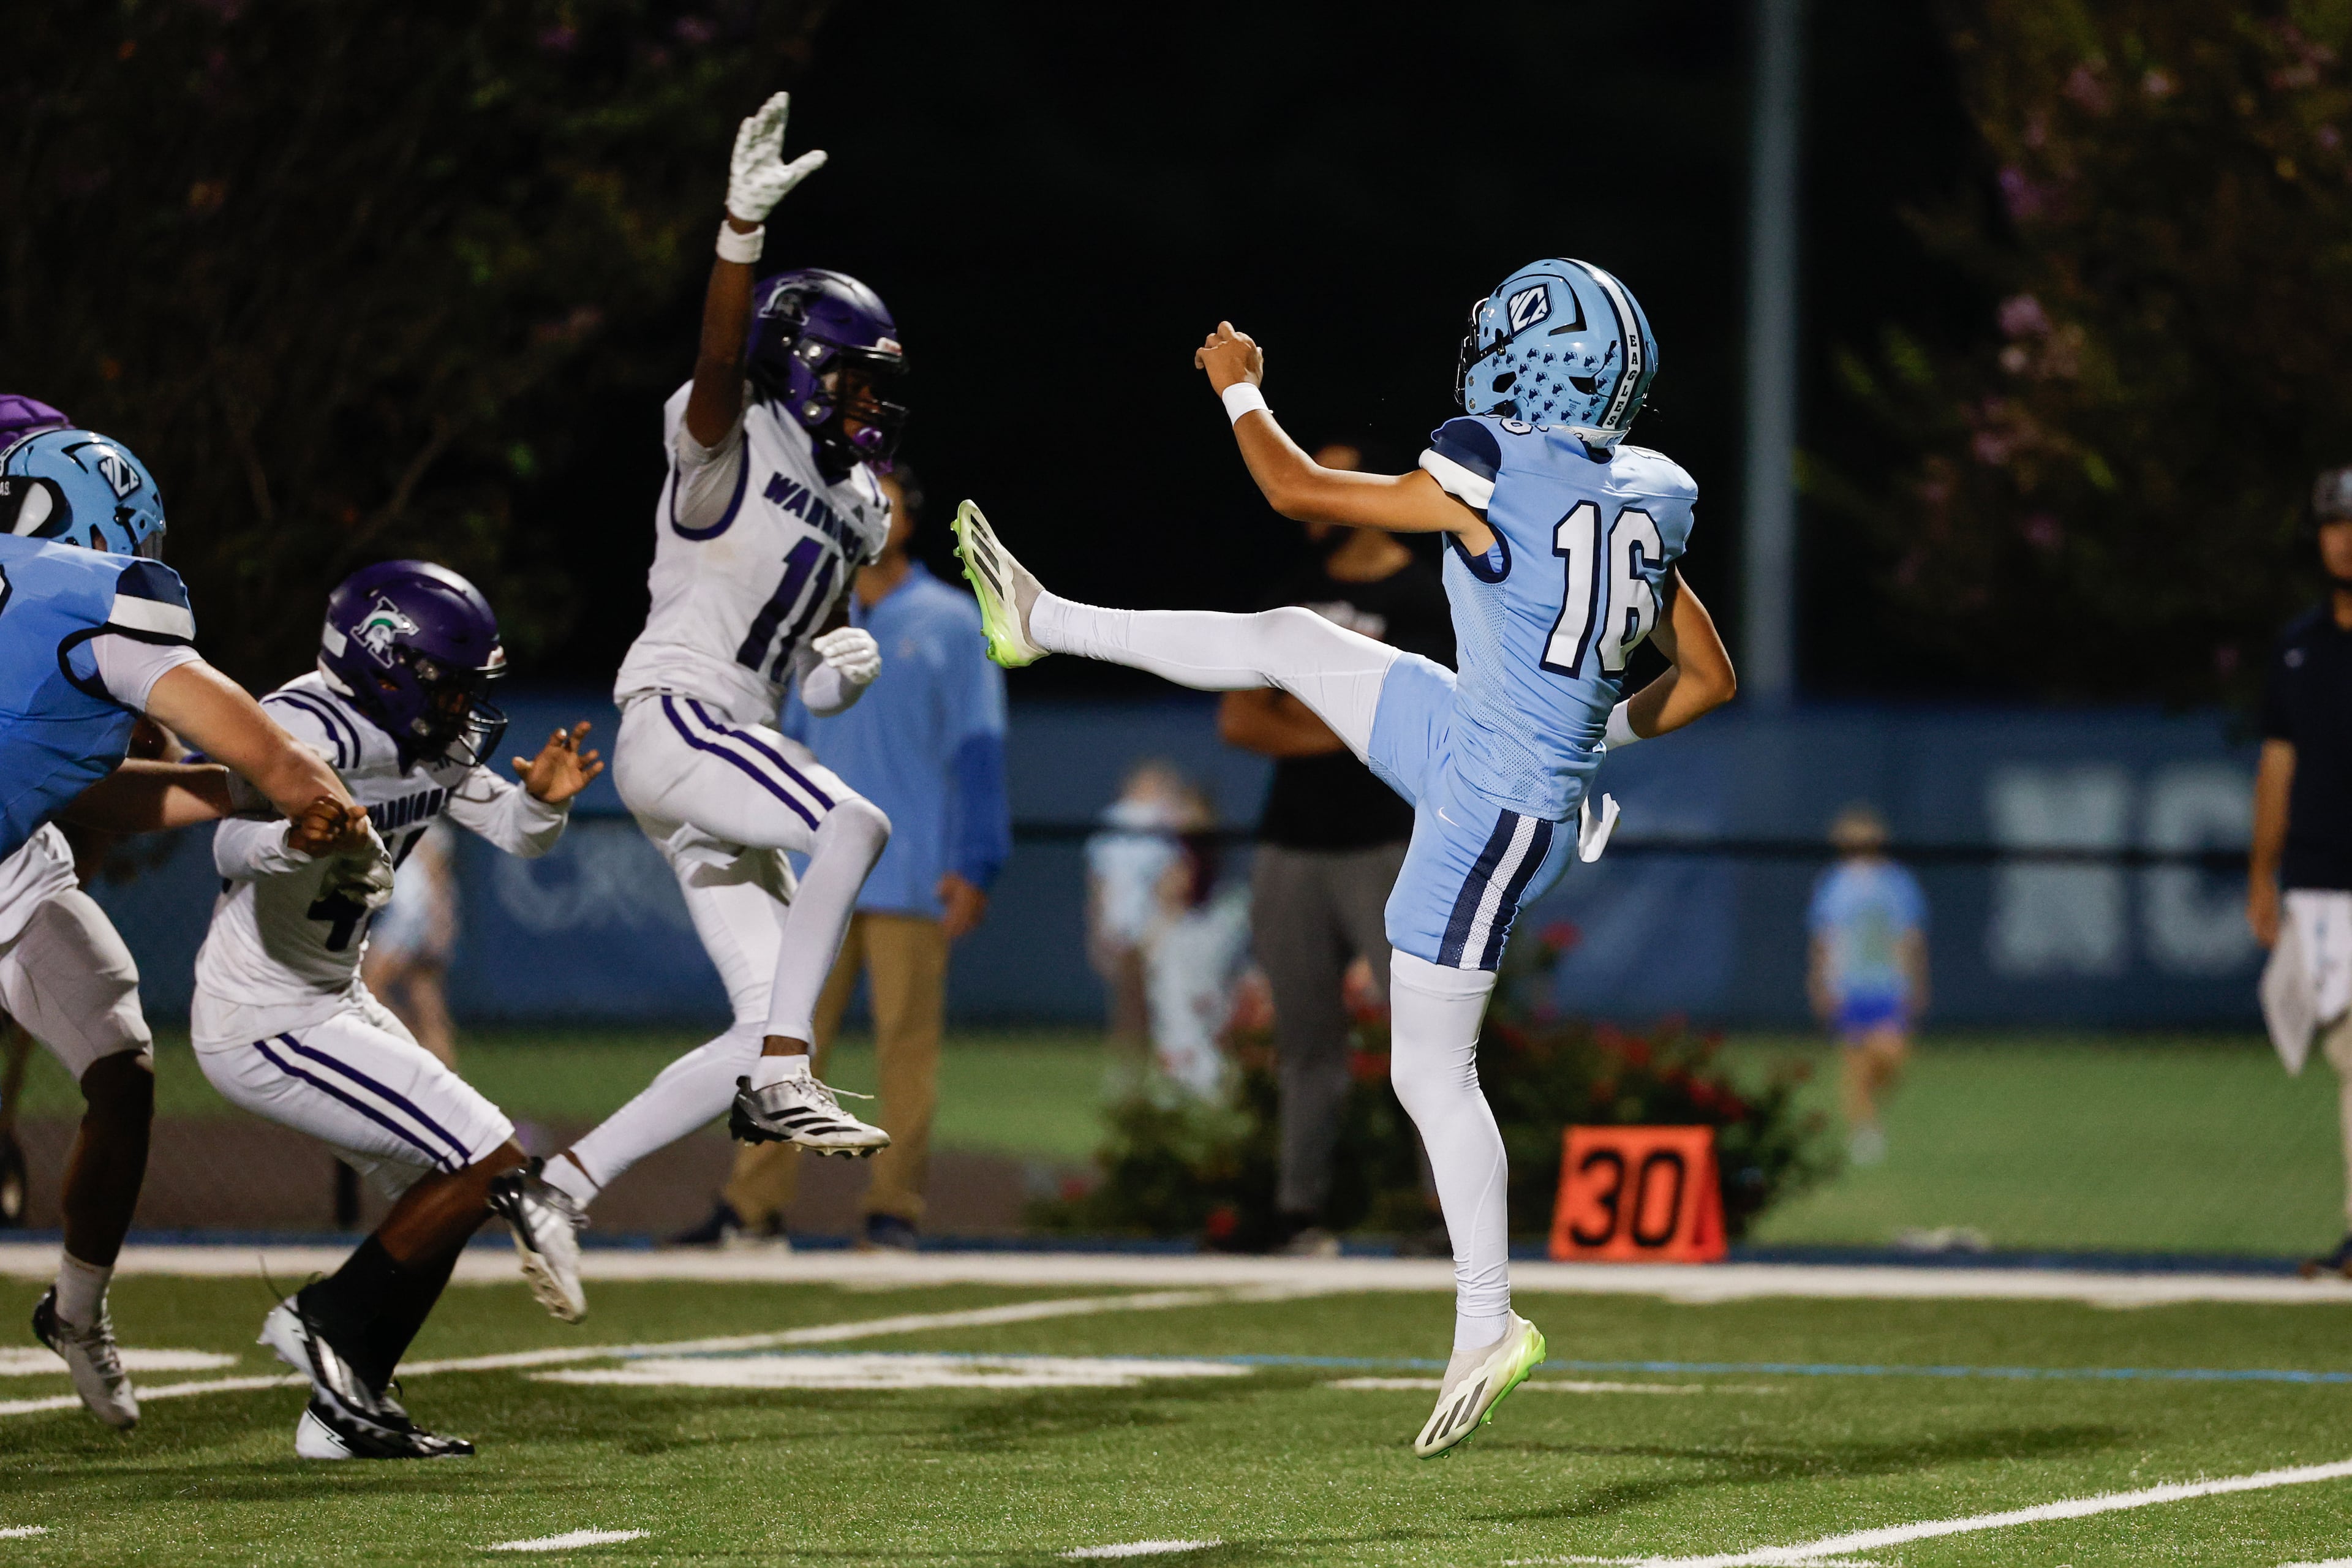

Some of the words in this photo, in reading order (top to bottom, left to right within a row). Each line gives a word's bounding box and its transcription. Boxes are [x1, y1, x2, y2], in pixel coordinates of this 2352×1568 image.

[1607, 335, 1638, 426] EAGLES
[1539, 500, 1664, 680] 16
[1570, 1147, 1687, 1248] 30
